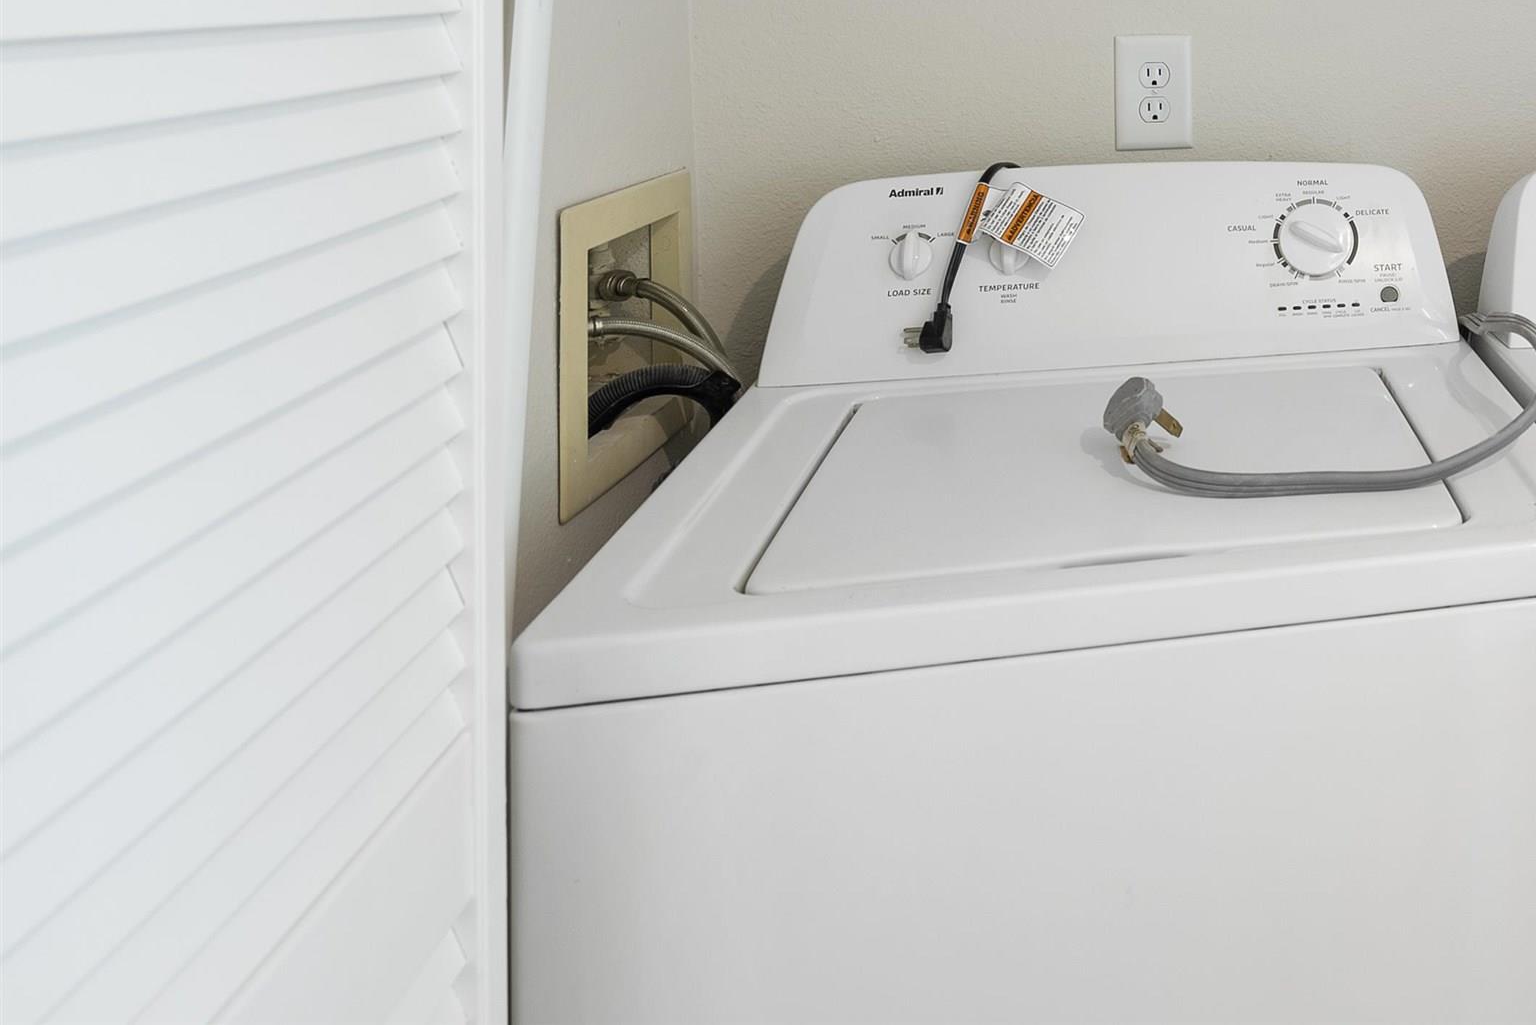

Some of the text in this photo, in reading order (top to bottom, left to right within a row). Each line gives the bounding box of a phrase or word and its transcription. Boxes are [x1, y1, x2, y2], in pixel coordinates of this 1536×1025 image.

[889, 187, 933, 198] Admiral
[1374, 263, 1402, 272] START
[979, 282, 1040, 292] TEMPERATURE
[887, 289, 911, 297] LOAD
